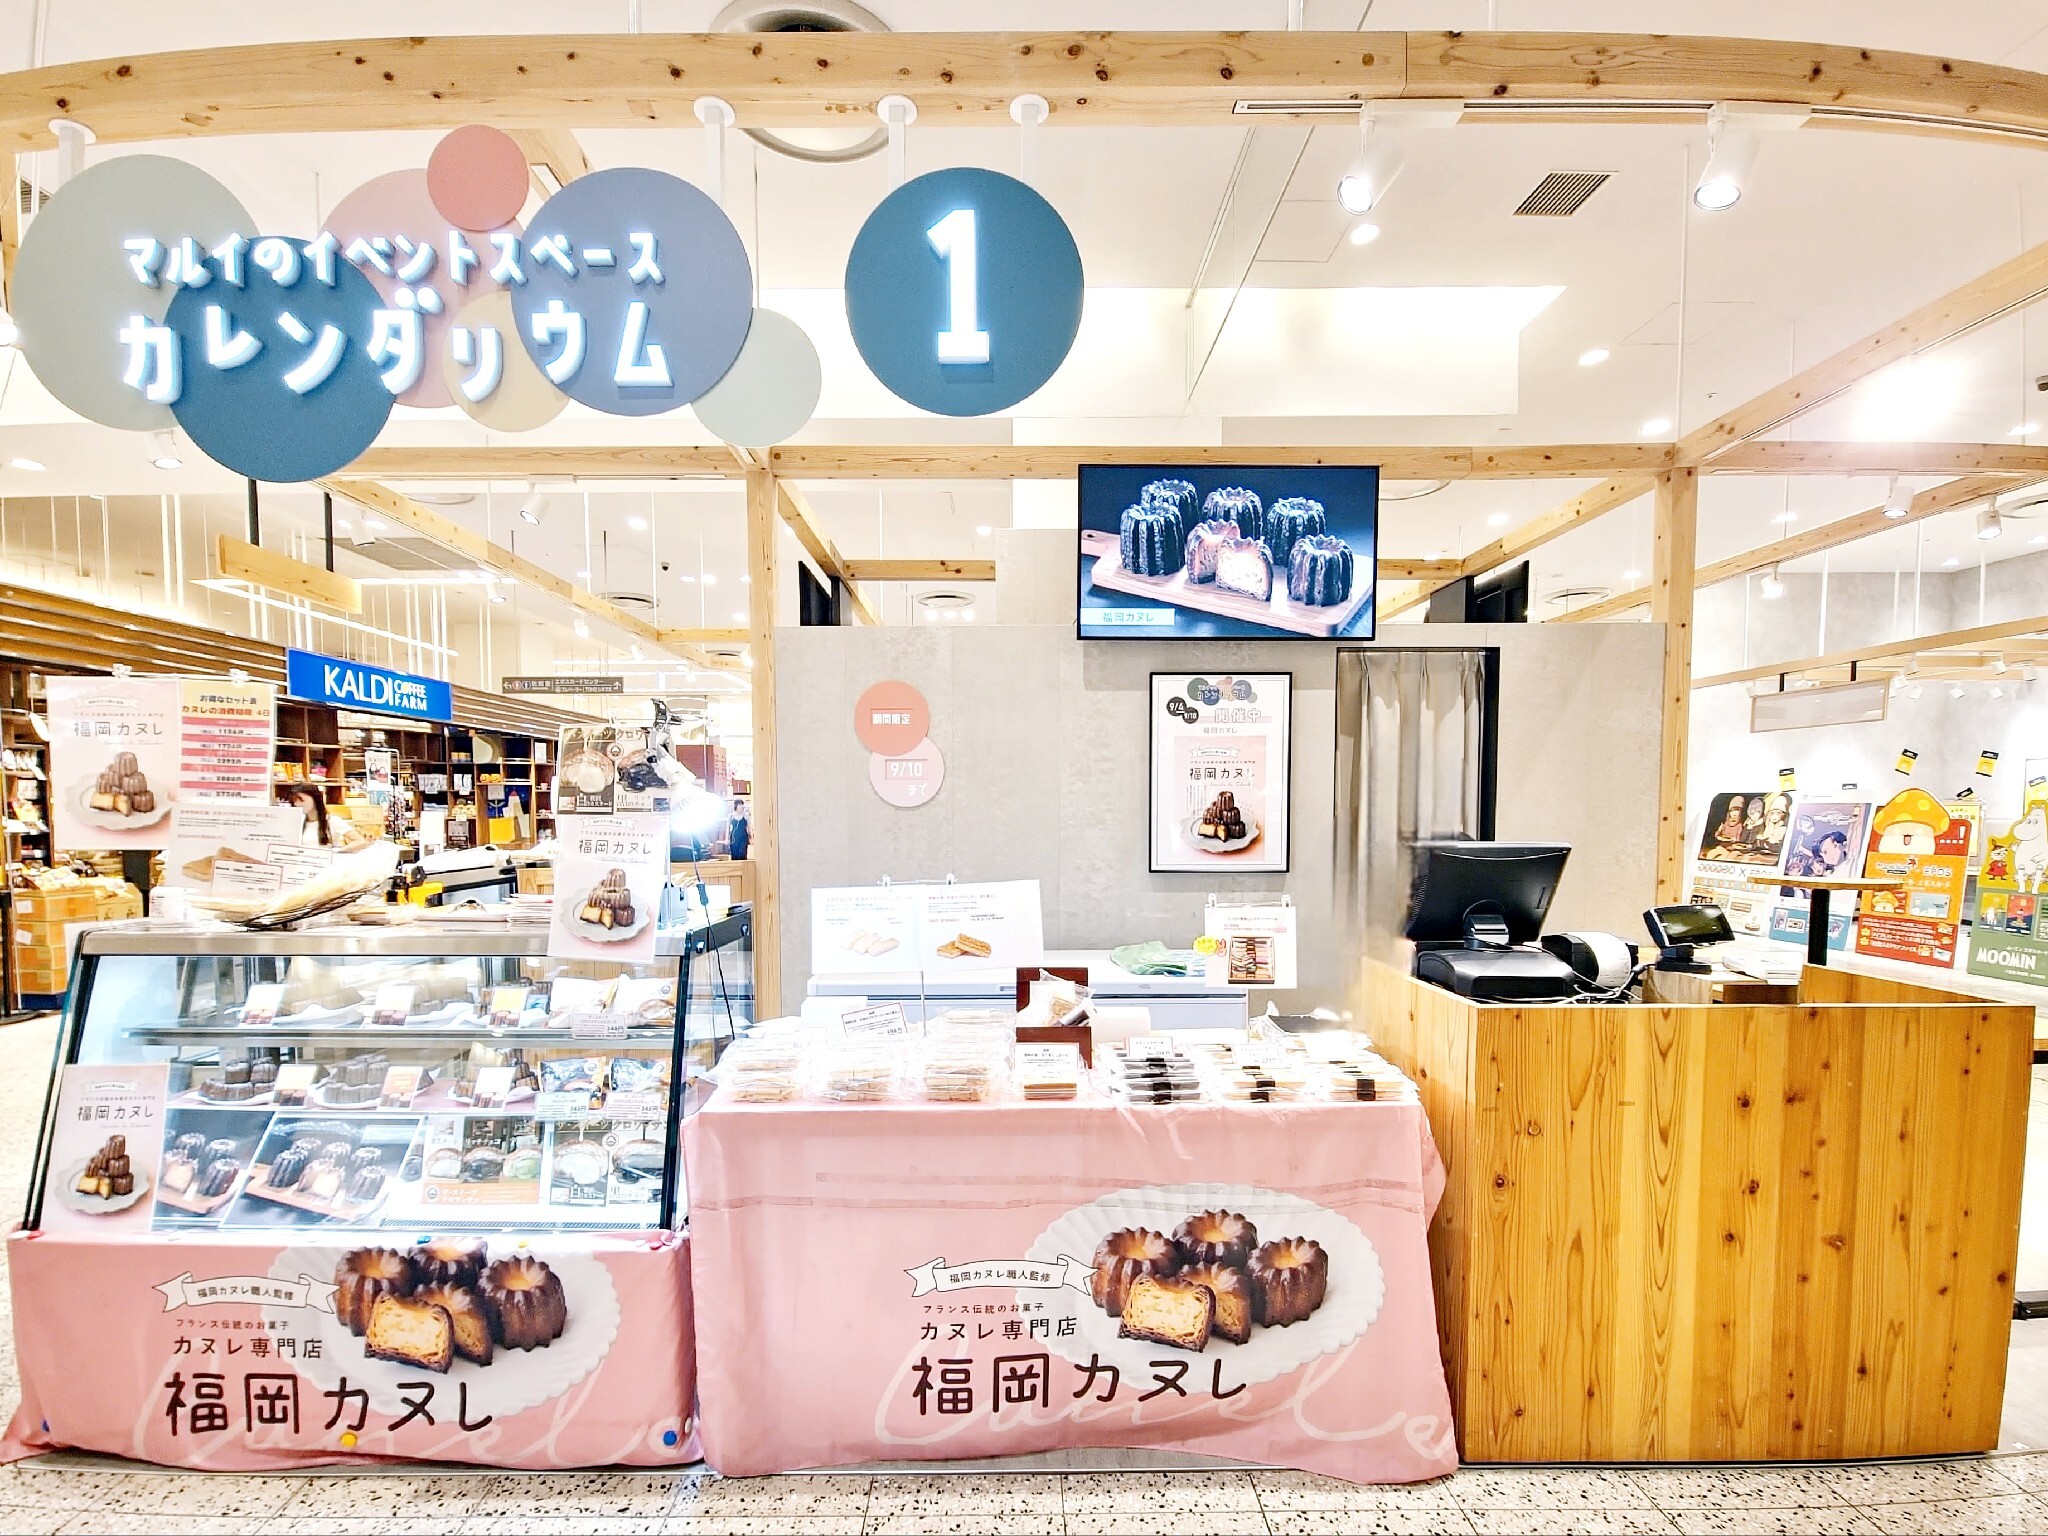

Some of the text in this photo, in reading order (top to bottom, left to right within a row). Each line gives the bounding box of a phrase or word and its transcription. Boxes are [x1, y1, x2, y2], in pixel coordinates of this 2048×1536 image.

[122, 229, 665, 289] マルイのイベントスペース
[926, 208, 990, 364] 1
[119, 286, 675, 405] カレンダリウム
[323, 664, 427, 706] KALDI COFFEE
[394, 694, 428, 711] FARM
[872, 713, 911, 725] 期間限定
[1214, 707, 1262, 724] 開催中
[73, 721, 163, 738] 福岡カヌレ
[890, 761, 923, 777] 9/10
[908, 782, 928, 796] まで
[578, 839, 652, 854] 福岡カヌレ
[1976, 946, 2037, 971] MOOMIN
[77, 1105, 154, 1122] 福岡カヌレ
[949, 1269, 1052, 1284] 福岡カヌレ職人監修
[197, 1285, 294, 1301] 福岡カヌレ職人監修
[923, 1302, 1044, 1315] フランス伝統のお菓子
[176, 1319, 289, 1331] フランス伝統のお菓子
[920, 1316, 1078, 1341] カヌレ専門店
[173, 1335, 323, 1359] カヌレ専門店
[911, 1353, 1248, 1416] 福岡カヌレ
[164, 1372, 494, 1436] 福岡カヌレ
